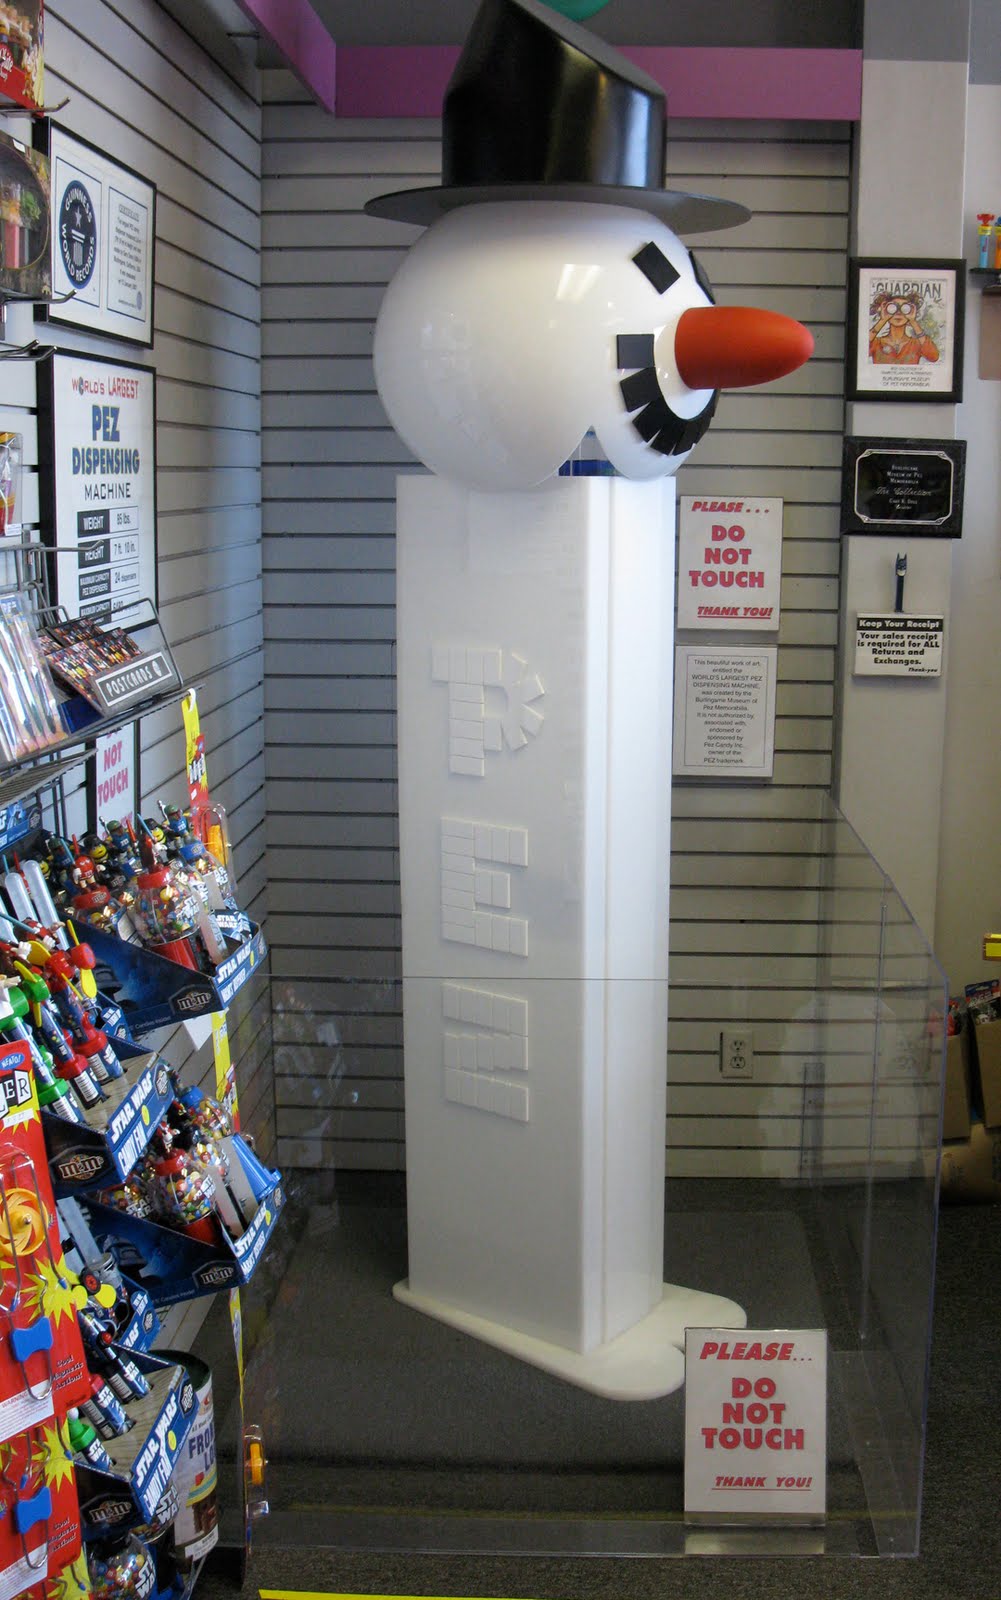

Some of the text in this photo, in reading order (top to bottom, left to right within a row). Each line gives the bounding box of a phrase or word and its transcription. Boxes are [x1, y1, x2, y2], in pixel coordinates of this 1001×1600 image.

[64, 187, 92, 223] GUINNESS
[62, 223, 95, 281] WORLD RECORDS
[876, 282, 941, 299] GUARDIAN
[72, 376, 139, 400] WORLD'S LARGEST
[91, 404, 121, 442] PEZ
[72, 447, 140, 475] DISPENSING
[84, 482, 131, 501] MACHINE
[83, 515, 105, 531] WEIGHT
[711, 525, 745, 542] DO
[704, 548, 752, 565] NOT
[688, 570, 765, 588] TOUCH
[697, 606, 774, 617] THANK YOU!
[859, 620, 940, 629] Keep Your Receipt
[860, 632, 880, 640] Your
[907, 633, 938, 641] receipt
[867, 640, 905, 648] required
[873, 657, 921, 666] Exchanges.
[105, 664, 153, 698] POSTCARDS
[103, 741, 122, 772] NOT
[98, 768, 129, 807] TOUCH
[217, 958, 238, 984] STAR
[1, 1053, 21, 1069] NEATO!
[111, 1071, 153, 1144] STAR WARS
[118, 1121, 147, 1177] CANDY FAN
[234, 1226, 256, 1258] STAR
[123, 1321, 139, 1348] ARS
[732, 1377, 776, 1399] DO
[722, 1403, 786, 1424] NOT
[136, 1393, 177, 1488] STAR WARS
[701, 1428, 805, 1450] TOUCH
[144, 1455, 173, 1517] CANDY FAN
[714, 1476, 813, 1488] THANK YOU!
